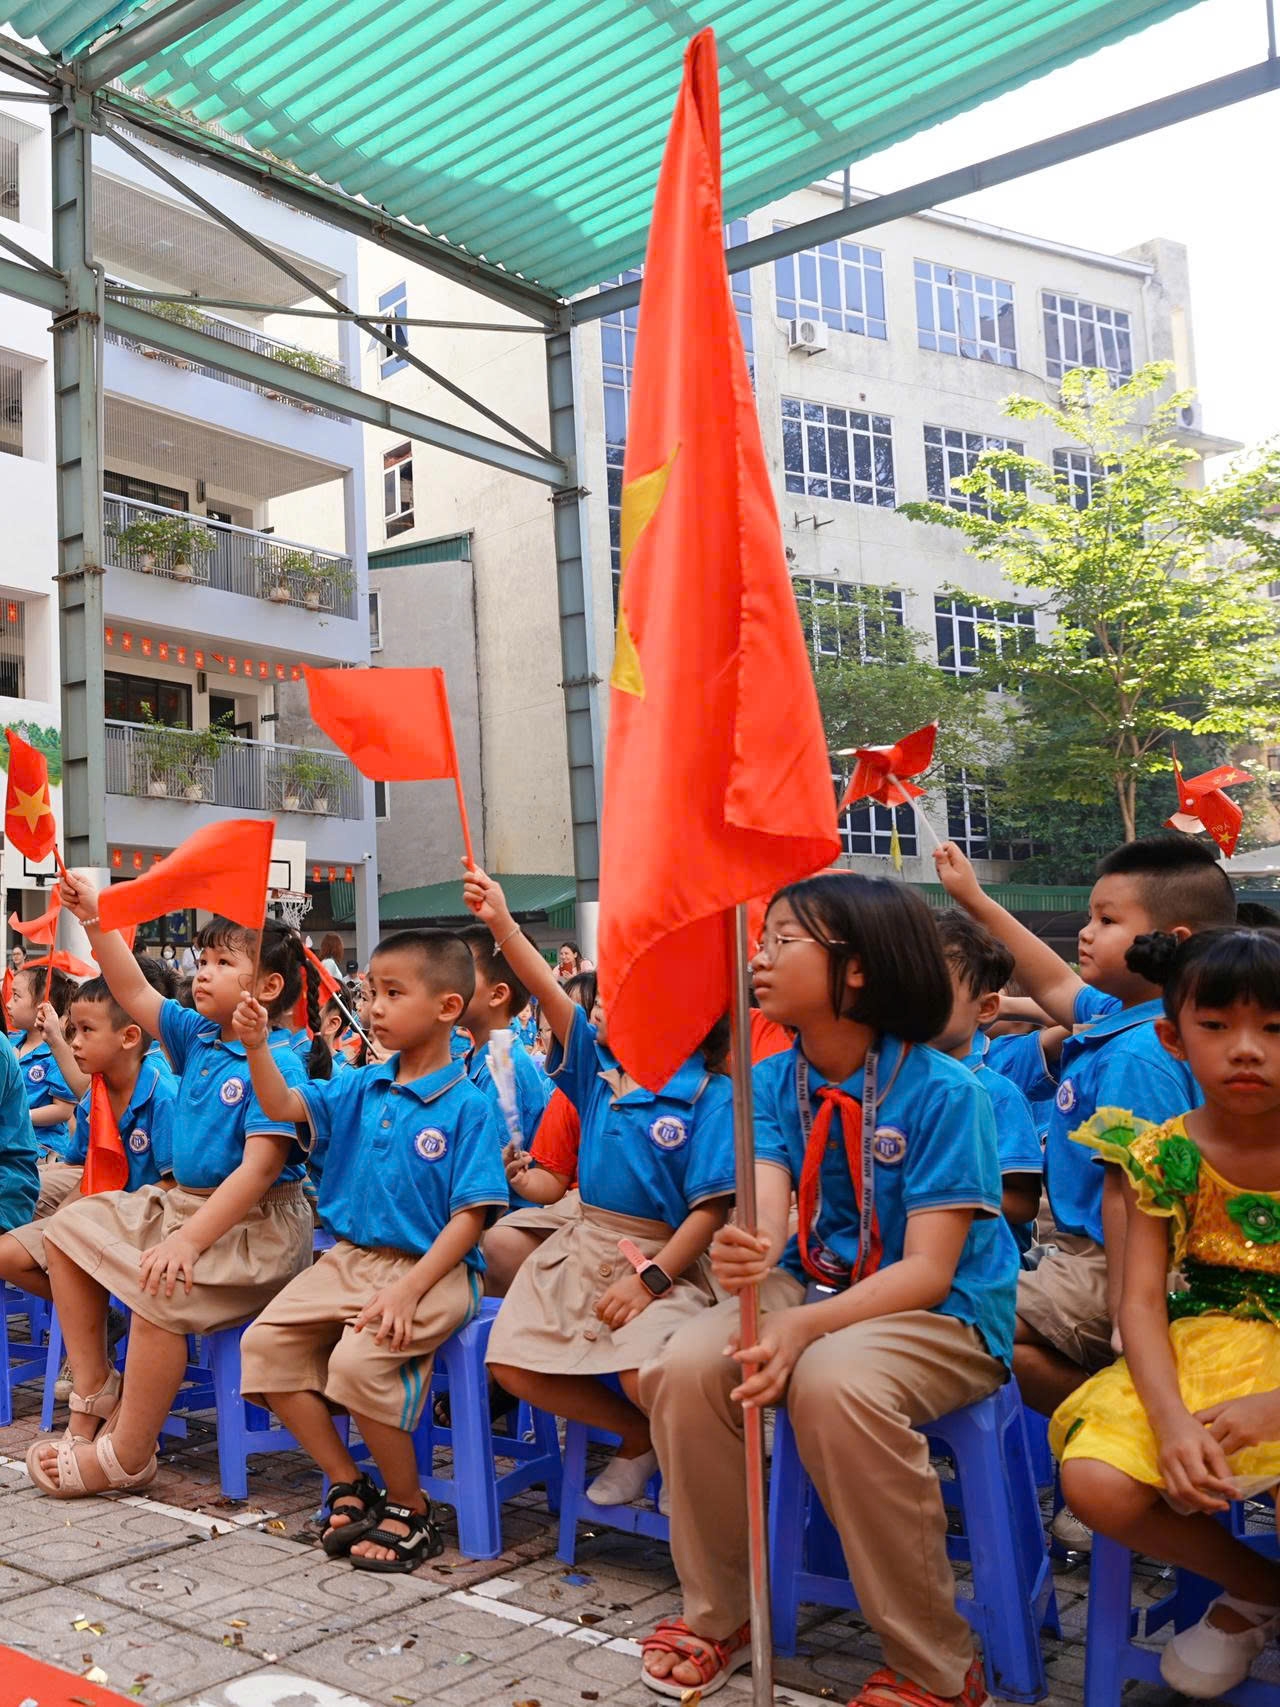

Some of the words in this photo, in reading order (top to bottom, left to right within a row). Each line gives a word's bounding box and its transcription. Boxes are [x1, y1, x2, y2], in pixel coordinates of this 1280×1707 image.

[864, 1086, 873, 1103] FAN
[863, 1136, 872, 1154] FAN
[863, 1156, 872, 1178] MINI
[863, 1187, 872, 1207] FAN
